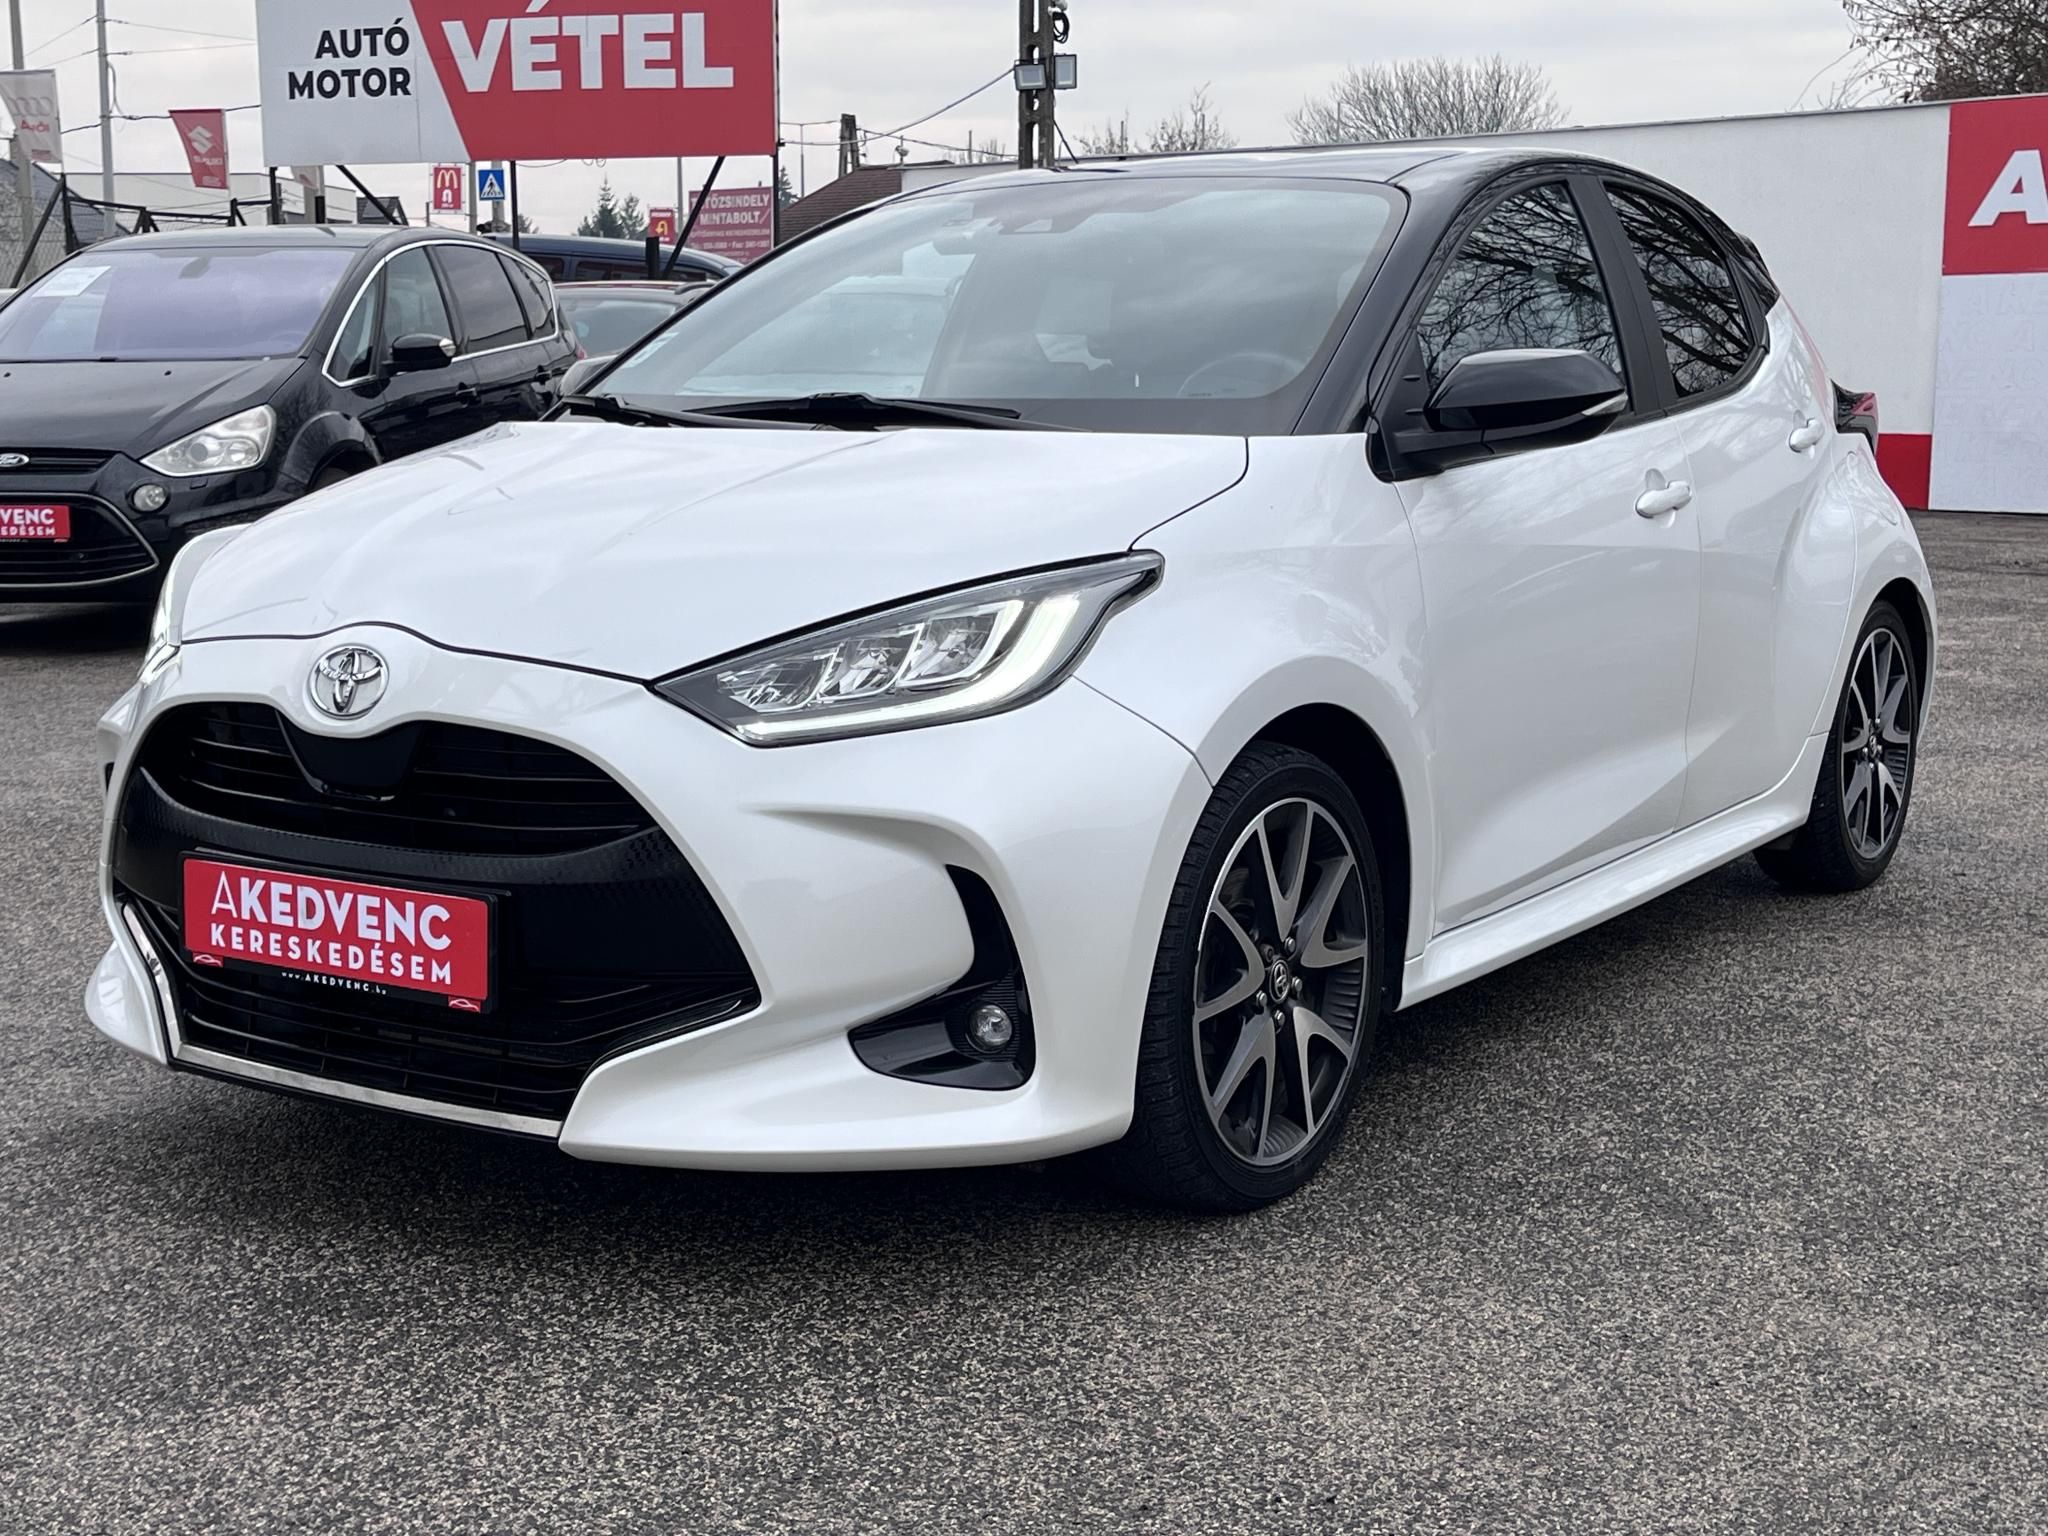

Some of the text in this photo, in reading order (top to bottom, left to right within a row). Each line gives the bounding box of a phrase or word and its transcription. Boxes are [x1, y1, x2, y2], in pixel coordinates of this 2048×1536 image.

[314, 17, 410, 60] AUTÓ
[440, 0, 735, 93] VÉTEL
[288, 66, 412, 100] MOTOR
[690, 193, 770, 209] TTŐZSINDELY
[699, 211, 761, 225] MINTABOLT
[210, 922, 452, 985] KERESKEDÉSEM
